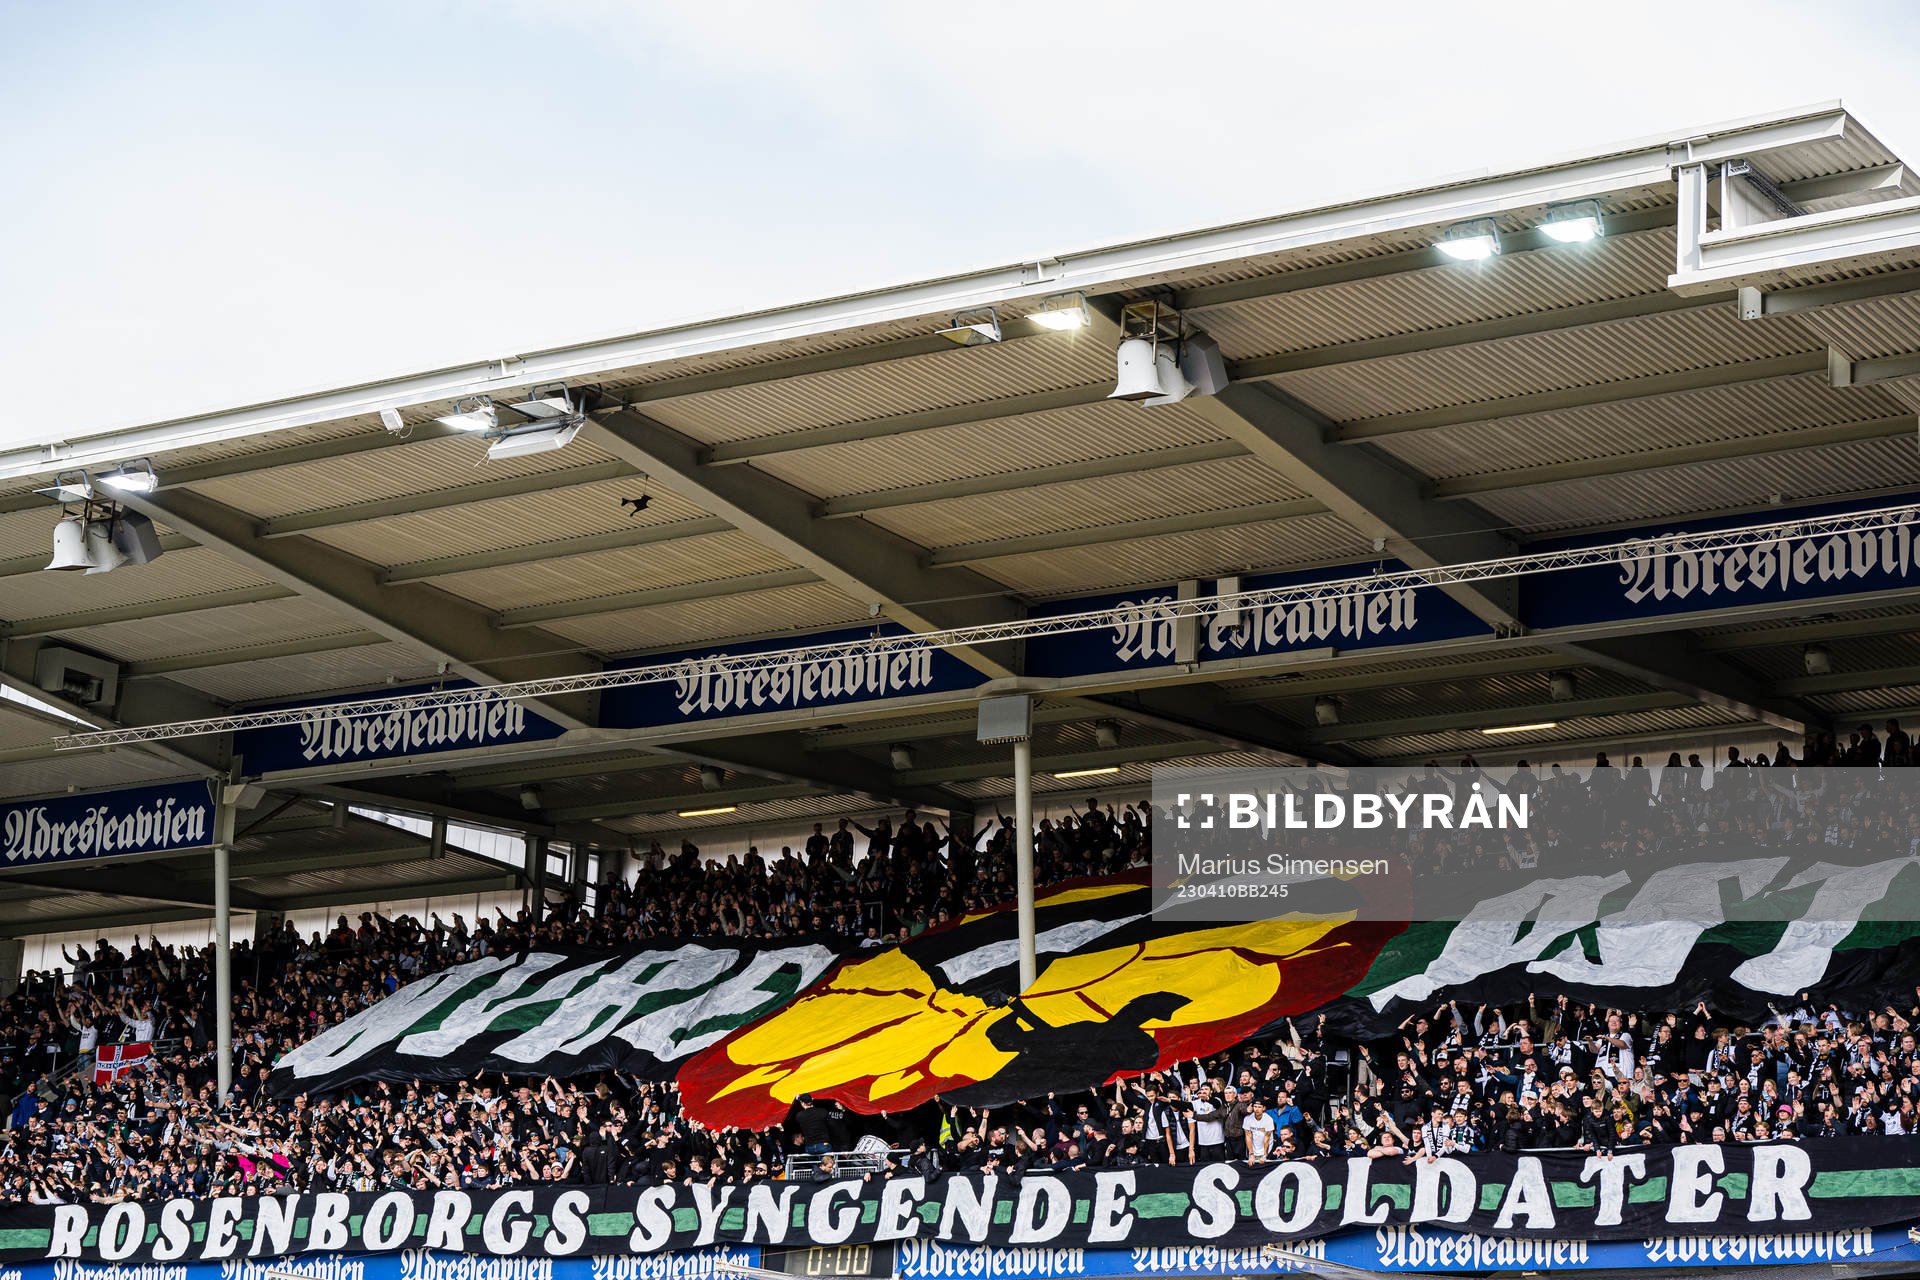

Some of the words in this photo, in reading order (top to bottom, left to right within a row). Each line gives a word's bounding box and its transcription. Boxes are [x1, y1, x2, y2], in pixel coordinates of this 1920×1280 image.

[4, 797, 206, 862] Adresseavisen
[45, 1189, 591, 1260] ROSENBORGS
[629, 1168, 1137, 1253] SYNGENDE
[1187, 1144, 1812, 1239] SOLDATER
[807, 1246, 869, 1275] 0:00
